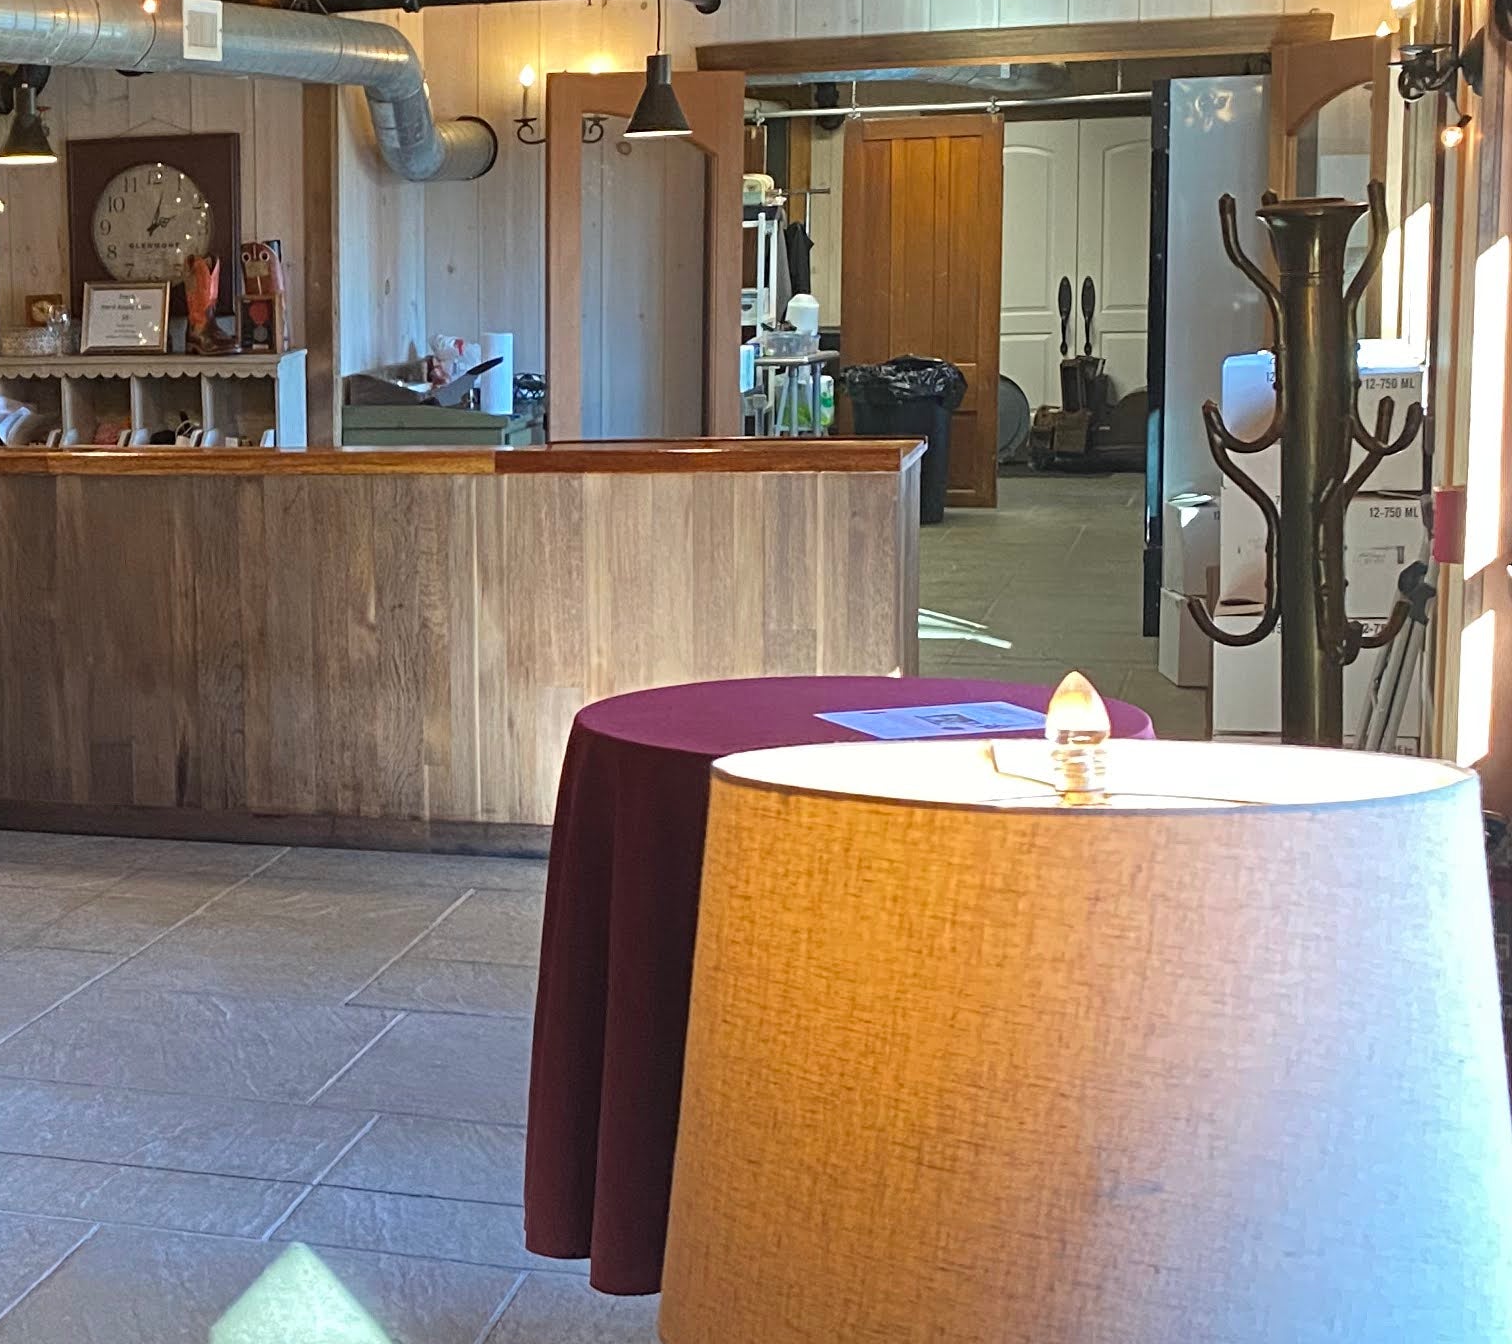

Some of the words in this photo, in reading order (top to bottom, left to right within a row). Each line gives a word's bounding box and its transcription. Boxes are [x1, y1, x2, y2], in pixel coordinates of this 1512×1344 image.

[123, 176, 137, 193] 11
[108, 196, 125, 213] 10
[100, 219, 111, 236] 9
[106, 244, 118, 260] 8
[1365, 378, 1398, 389] 12-750
[1400, 377, 1415, 389] ML
[1369, 507, 1402, 518] 12-750
[1404, 507, 1419, 517] ML
